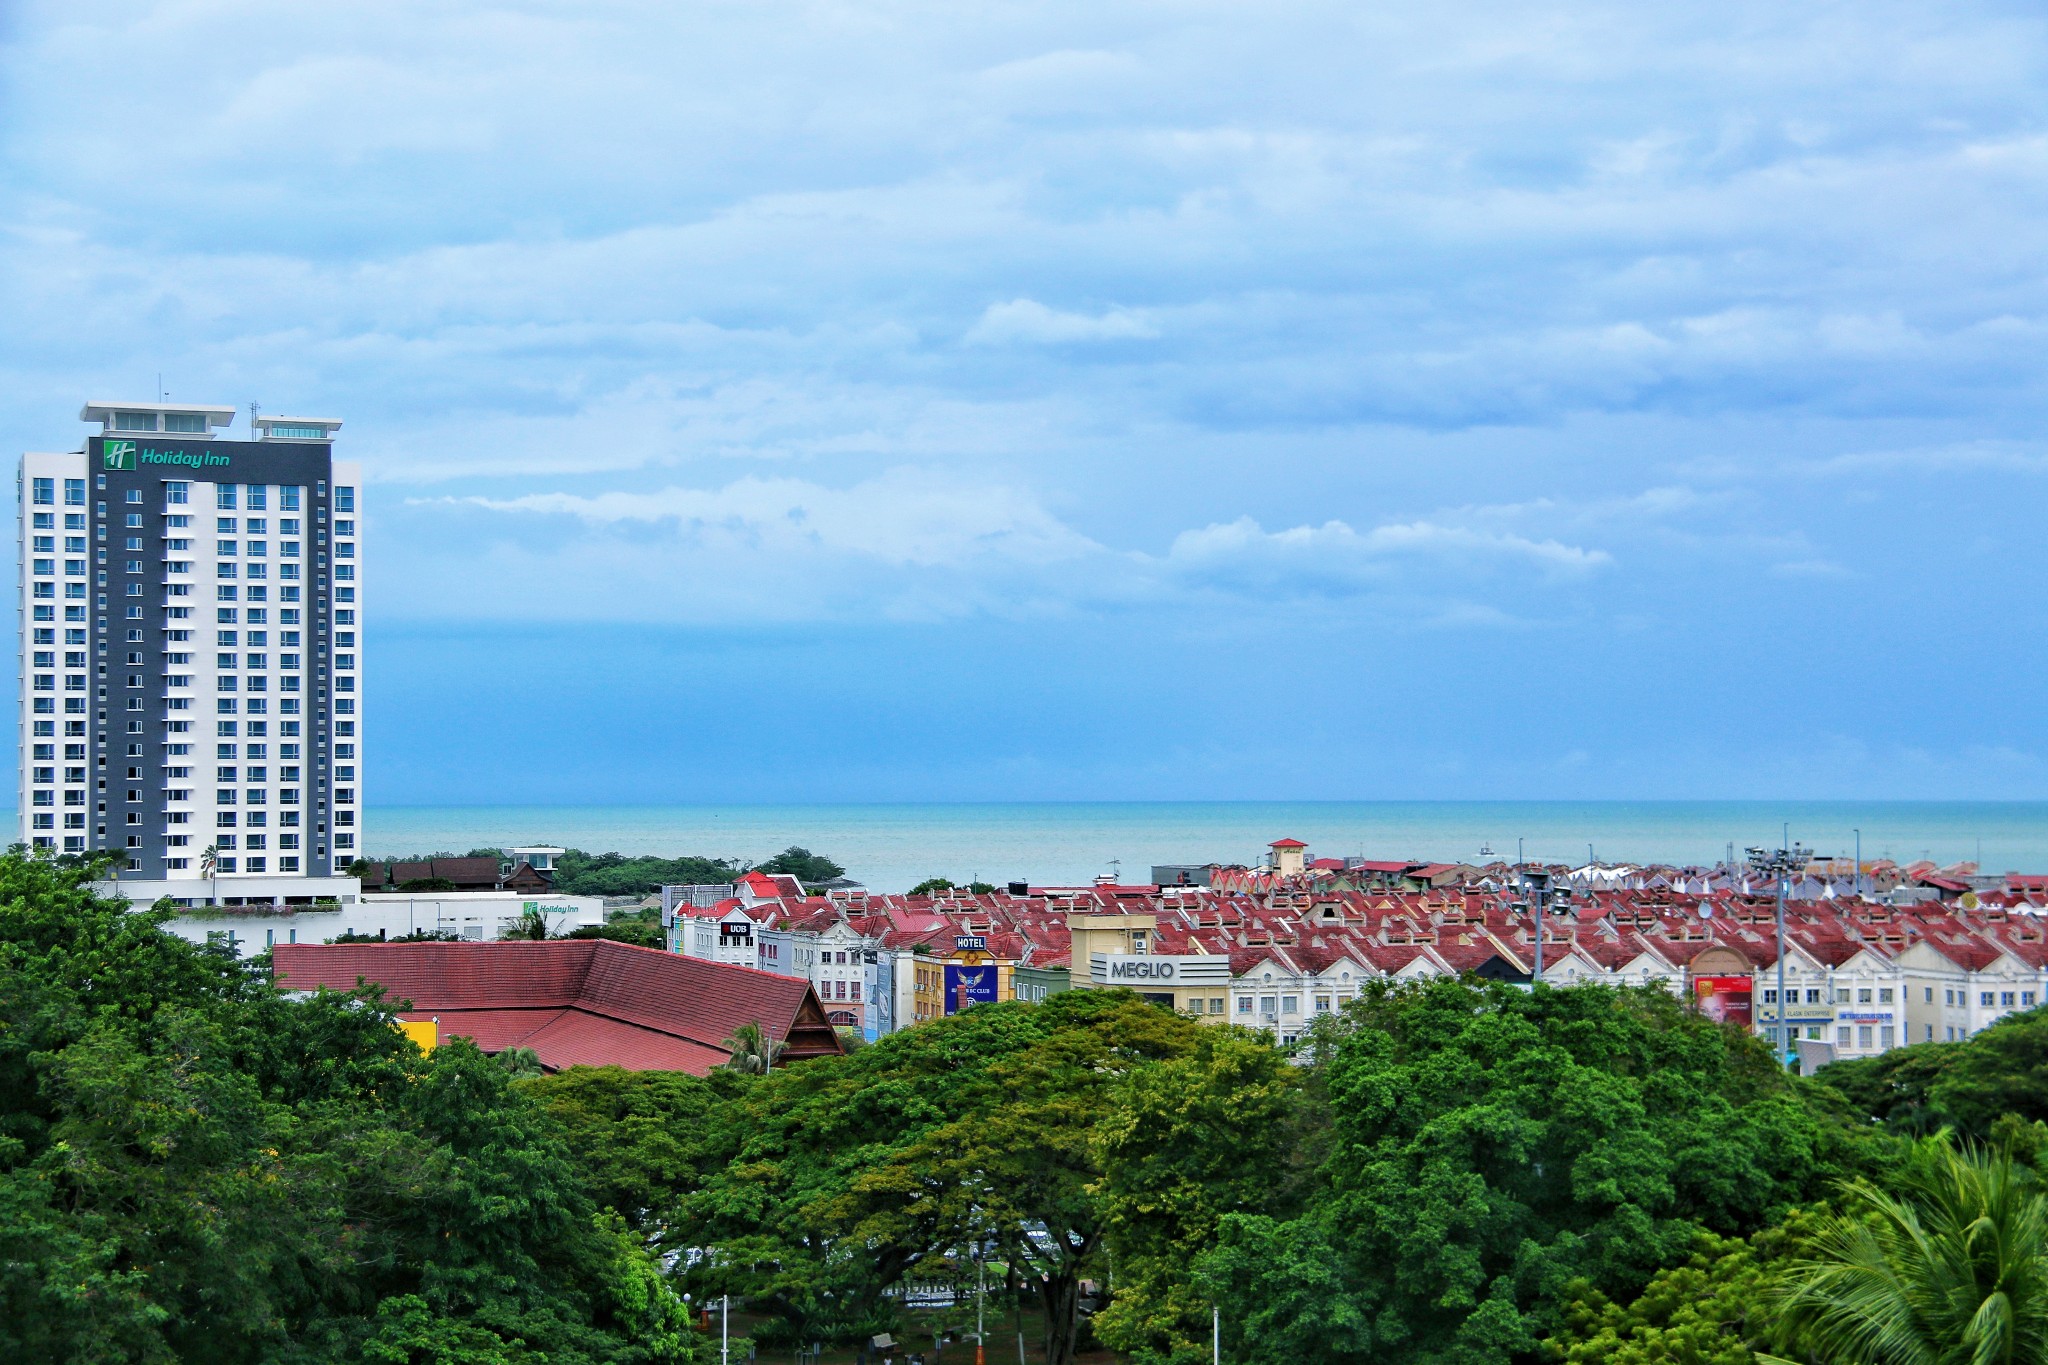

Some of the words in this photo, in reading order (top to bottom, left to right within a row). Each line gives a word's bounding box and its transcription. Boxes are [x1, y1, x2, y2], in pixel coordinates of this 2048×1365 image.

[141, 448, 203, 469] Holiday
[205, 450, 230, 466] Inn
[540, 904, 567, 914] Holiday
[567, 904, 579, 913] Inn
[730, 925, 747, 933] UOB
[957, 938, 984, 948] HOTEL
[1111, 962, 1174, 978] MEGLIO
